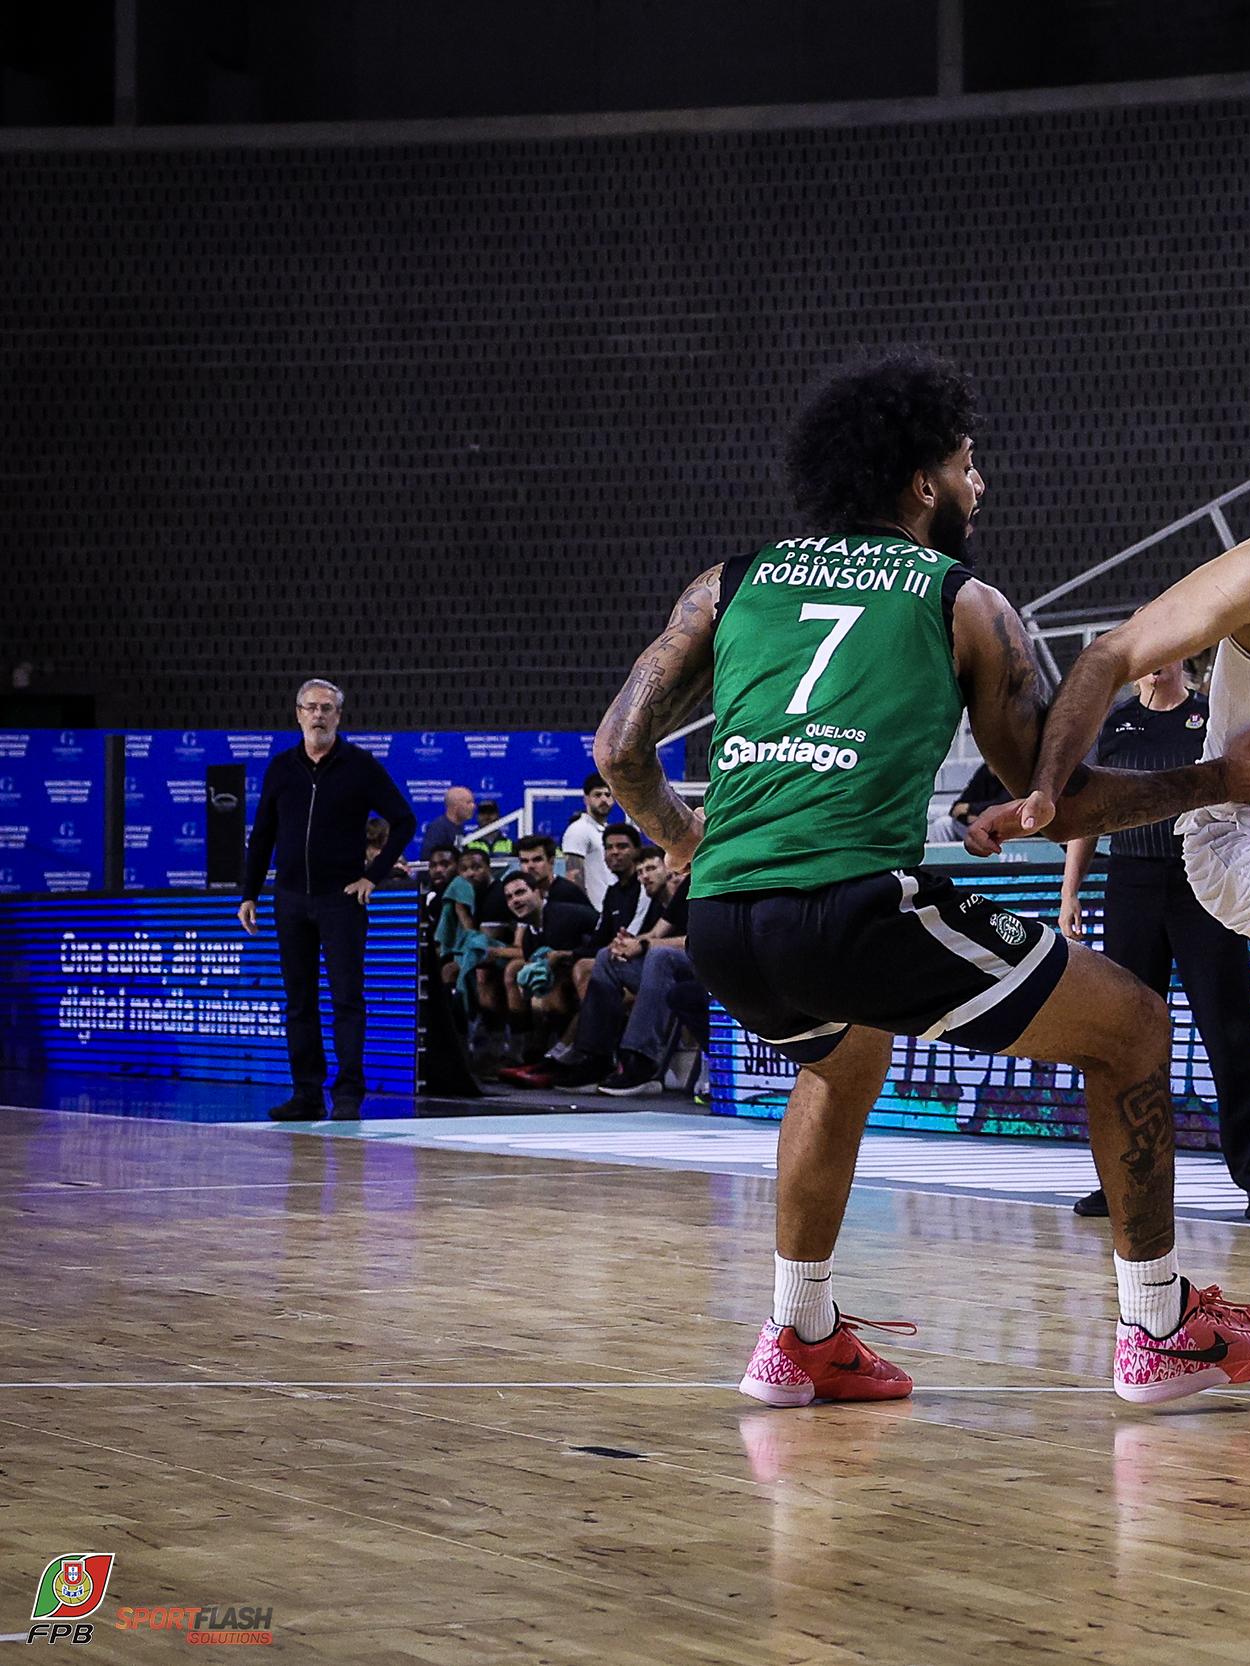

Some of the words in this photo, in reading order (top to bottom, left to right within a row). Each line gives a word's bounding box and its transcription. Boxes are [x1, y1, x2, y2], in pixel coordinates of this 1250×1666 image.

[752, 563, 899, 591] ROBINSON
[903, 570, 931, 598] III
[784, 602, 866, 714] 7
[717, 735, 858, 772] Santiago
[805, 723, 867, 742] QUEIJOS
[60, 931, 103, 974] One
[172, 931, 198, 974] all
[201, 943, 244, 986] your
[59, 986, 125, 1044] digital
[130, 987, 194, 1033] media
